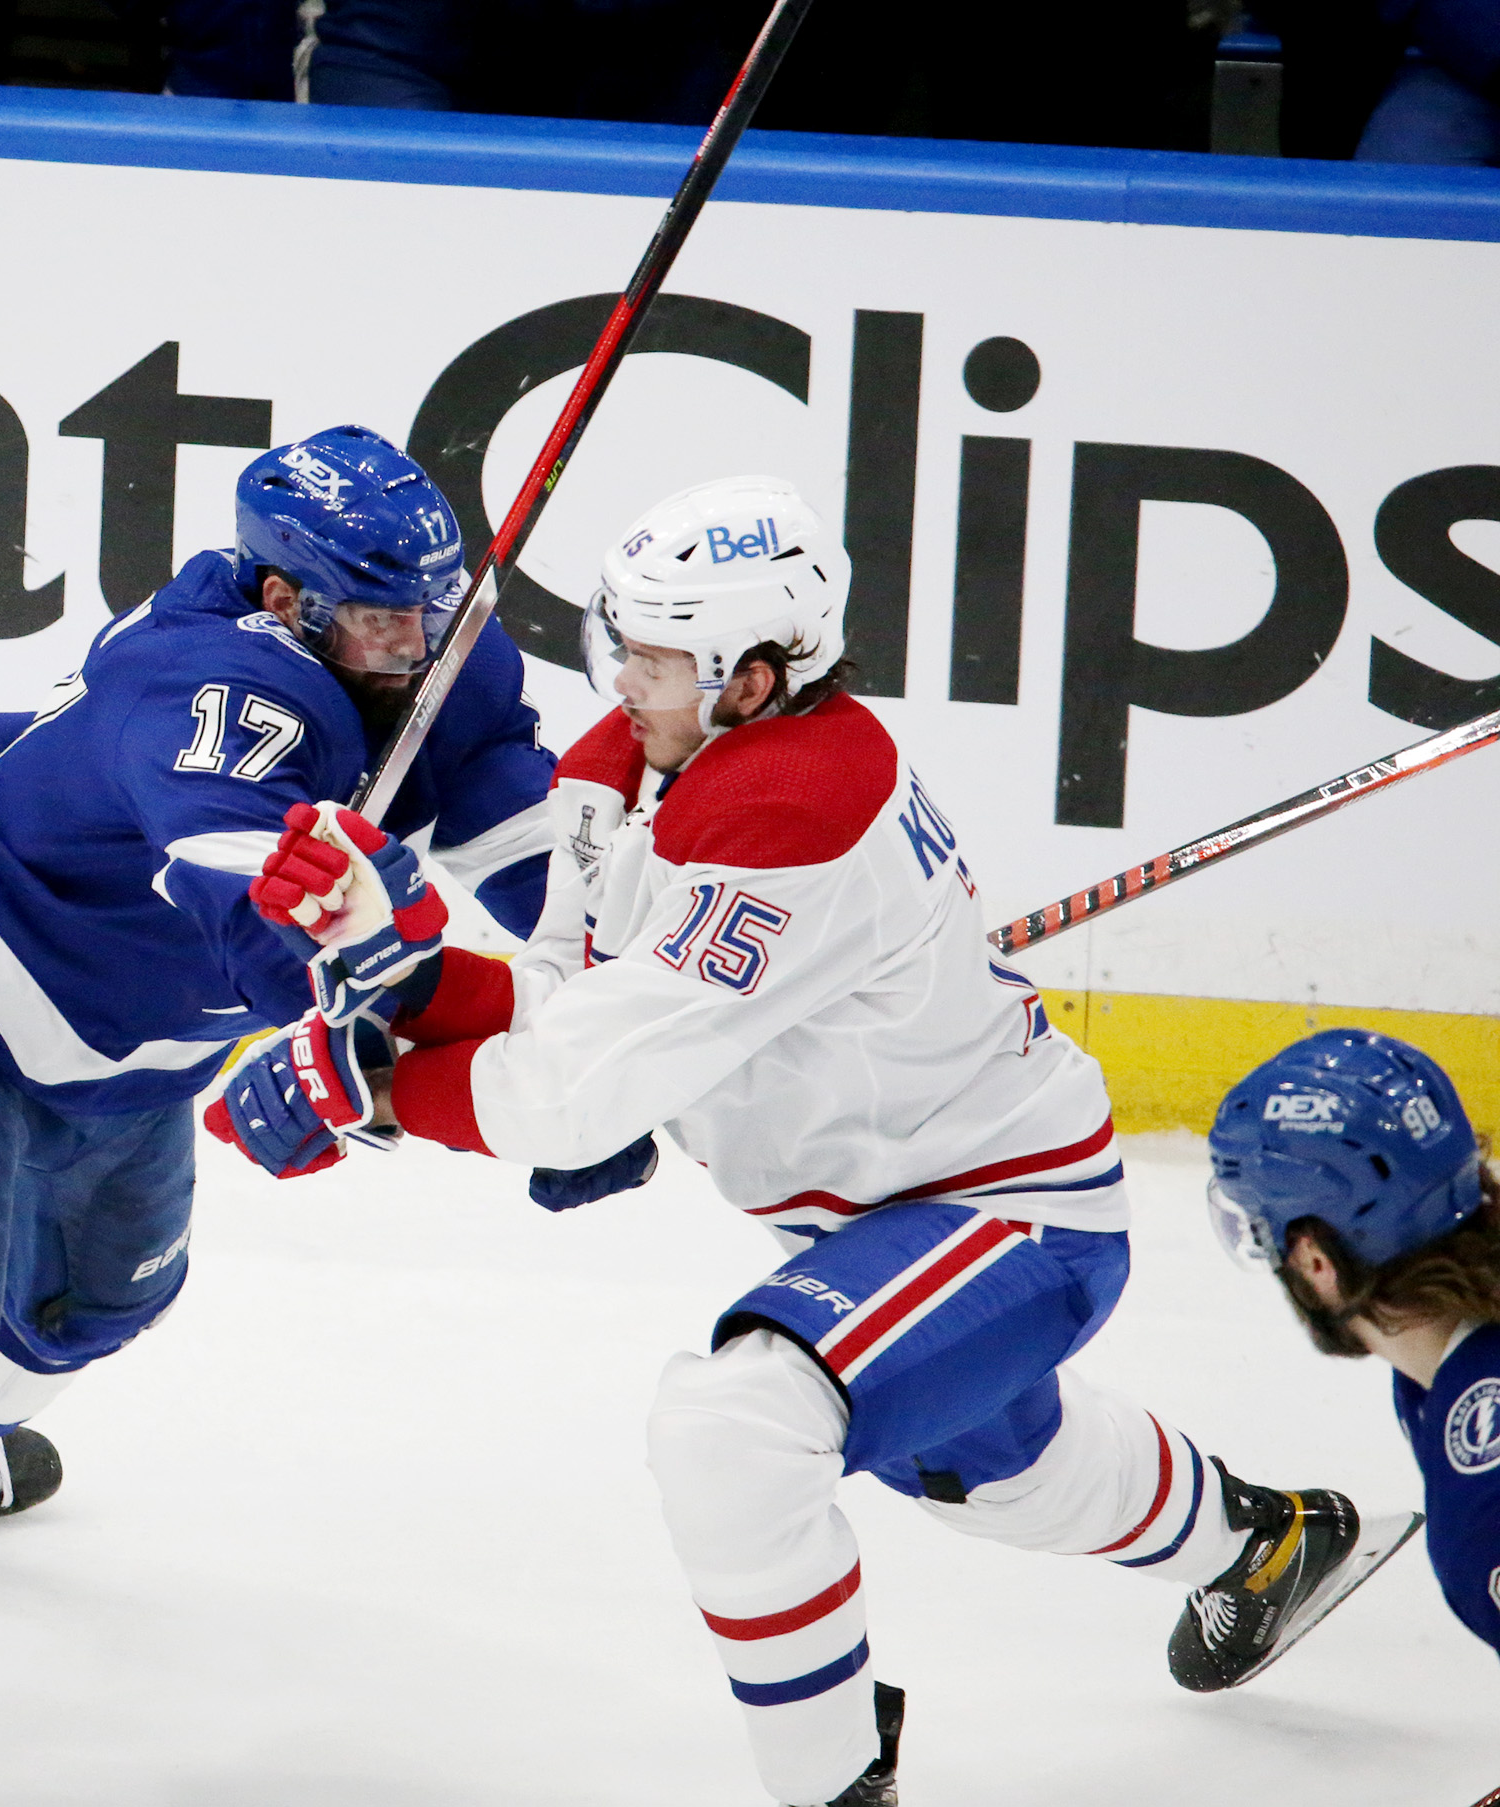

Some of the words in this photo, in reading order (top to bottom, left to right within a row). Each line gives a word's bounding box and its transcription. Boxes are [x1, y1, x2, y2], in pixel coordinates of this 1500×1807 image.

[281, 447, 354, 499] DEX
[420, 509, 449, 545] 17
[622, 529, 654, 558] 15
[706, 517, 779, 564] Bell
[406, 292, 1500, 829] Clips
[419, 542, 460, 567] BAUER
[173, 683, 304, 783] 17
[355, 940, 402, 976] BAUER
[653, 882, 792, 996] 15
[1263, 1094, 1341, 1122] DEX
[1402, 1095, 1442, 1141] 98
[1253, 1605, 1278, 1645] BAUER
